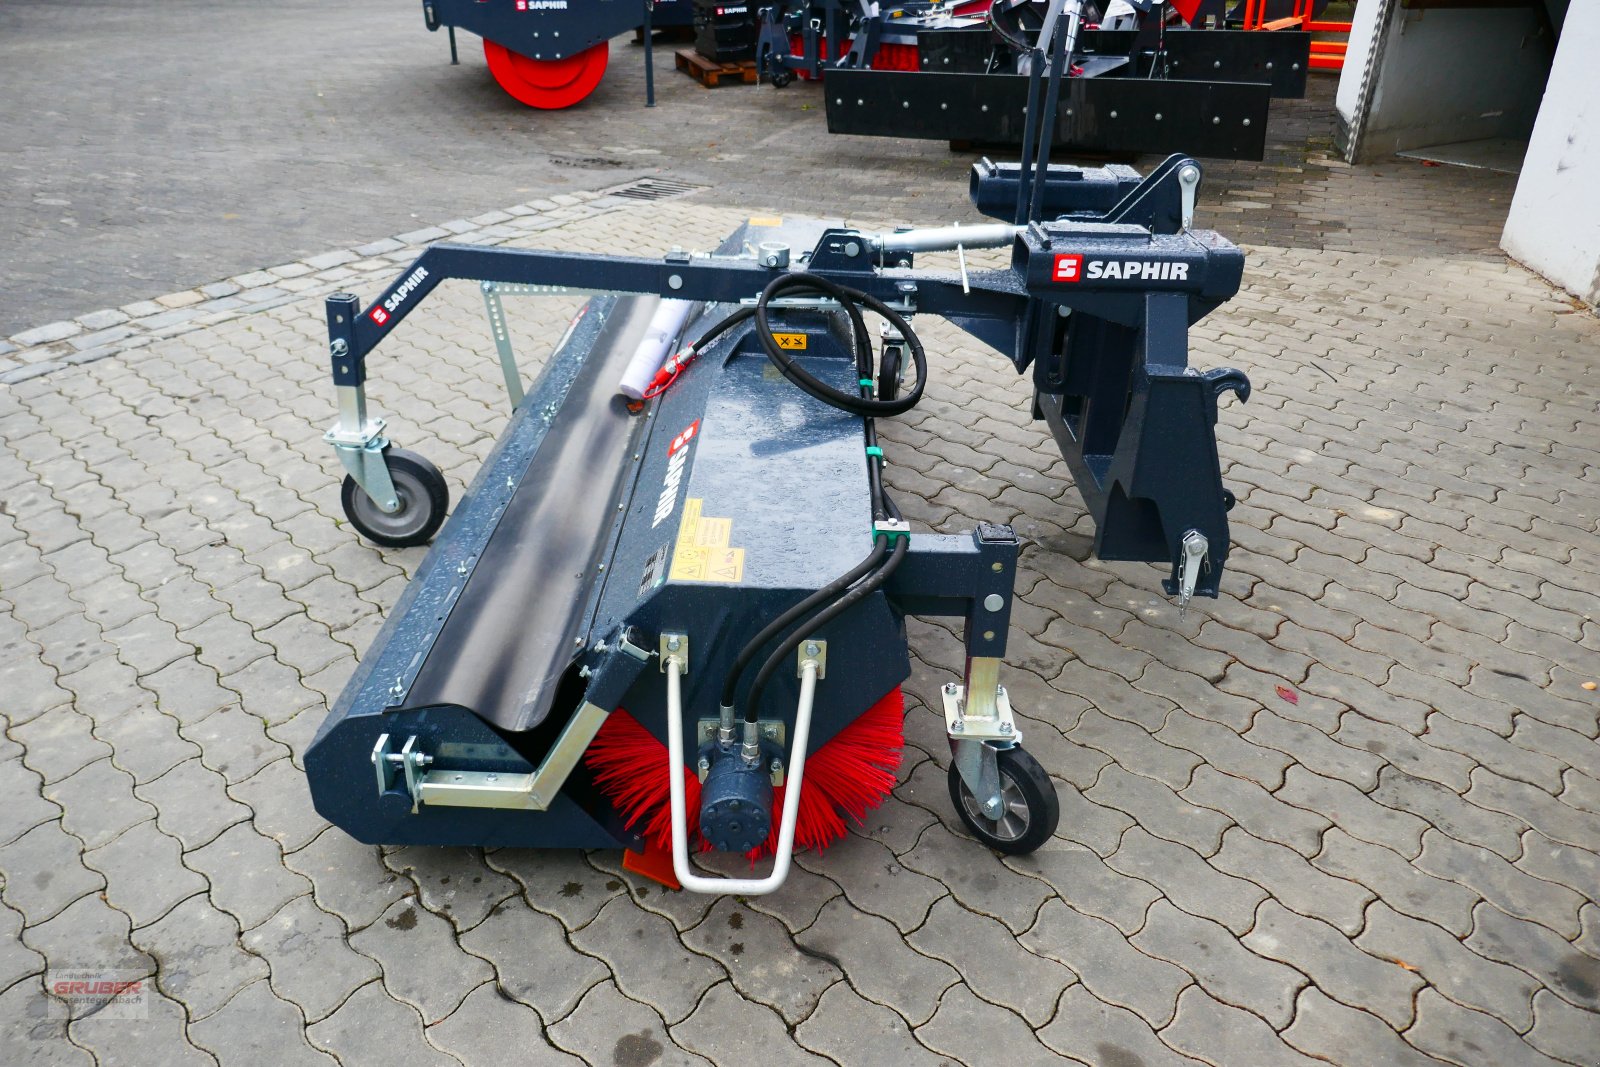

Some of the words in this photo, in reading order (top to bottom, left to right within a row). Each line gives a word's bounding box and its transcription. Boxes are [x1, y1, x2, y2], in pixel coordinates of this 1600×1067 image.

[528, 1, 567, 9] SAPHIR
[1087, 261, 1189, 280] SAPHIR
[384, 266, 429, 312] SAPHIR
[652, 444, 689, 529] SAPHIR
